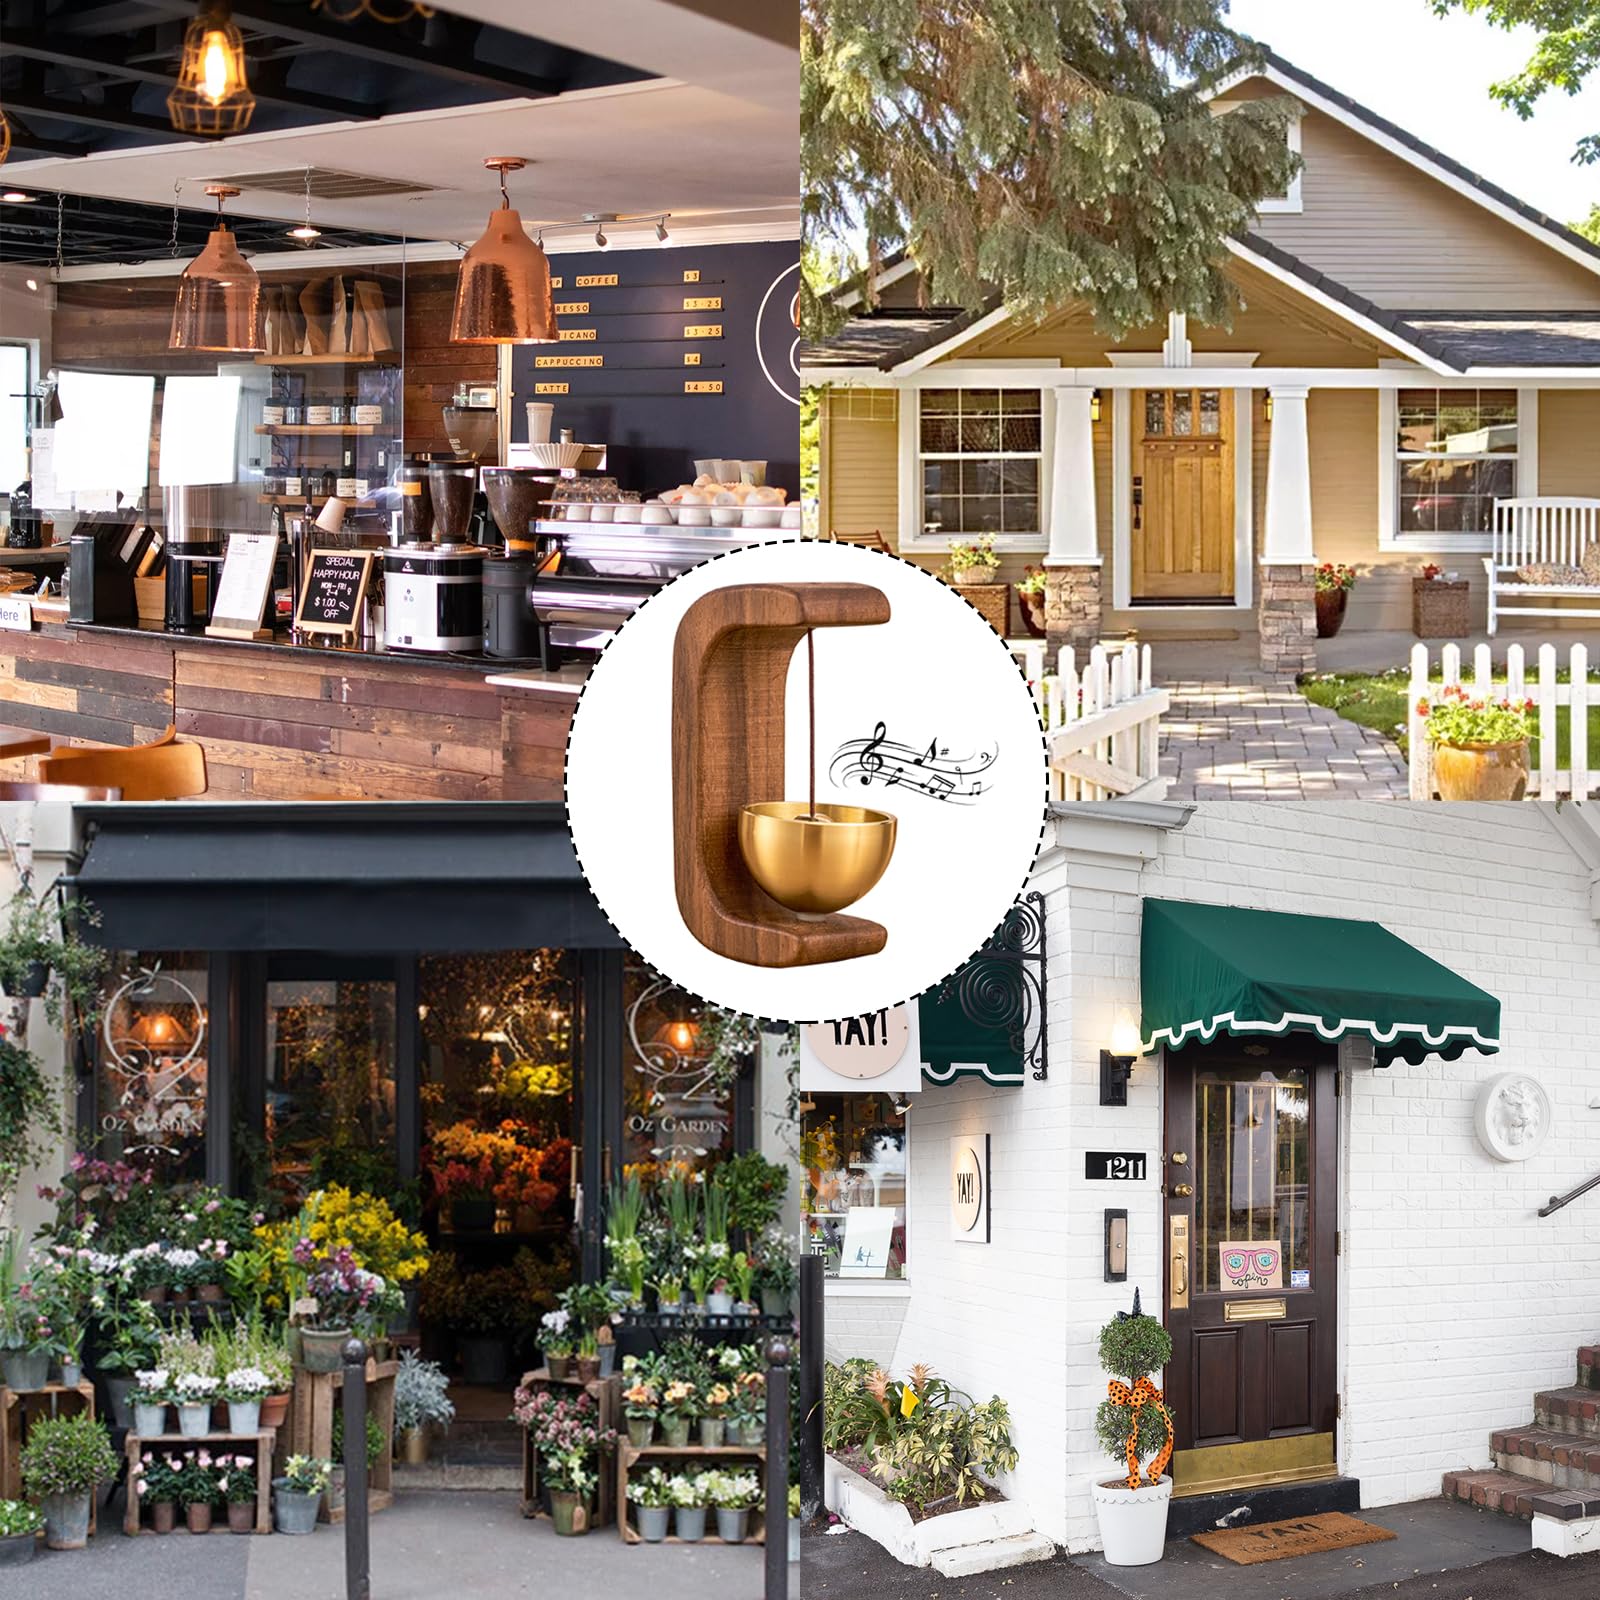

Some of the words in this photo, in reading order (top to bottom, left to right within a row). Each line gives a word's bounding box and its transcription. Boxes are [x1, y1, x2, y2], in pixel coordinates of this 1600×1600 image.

[577, 277, 616, 286] COFFEE
[556, 304, 588, 313] RESSO
[563, 331, 596, 339] ICANO
[536, 358, 602, 366] CAPPUCCINO
[325, 557, 355, 567] SPECIAL
[313, 569, 339, 579] HAPPY
[339, 570, 360, 580] HOUR
[323, 609, 340, 619] OFF
[1105, 1156, 1144, 1179] 1211
[957, 1172, 974, 1204] YAY!
